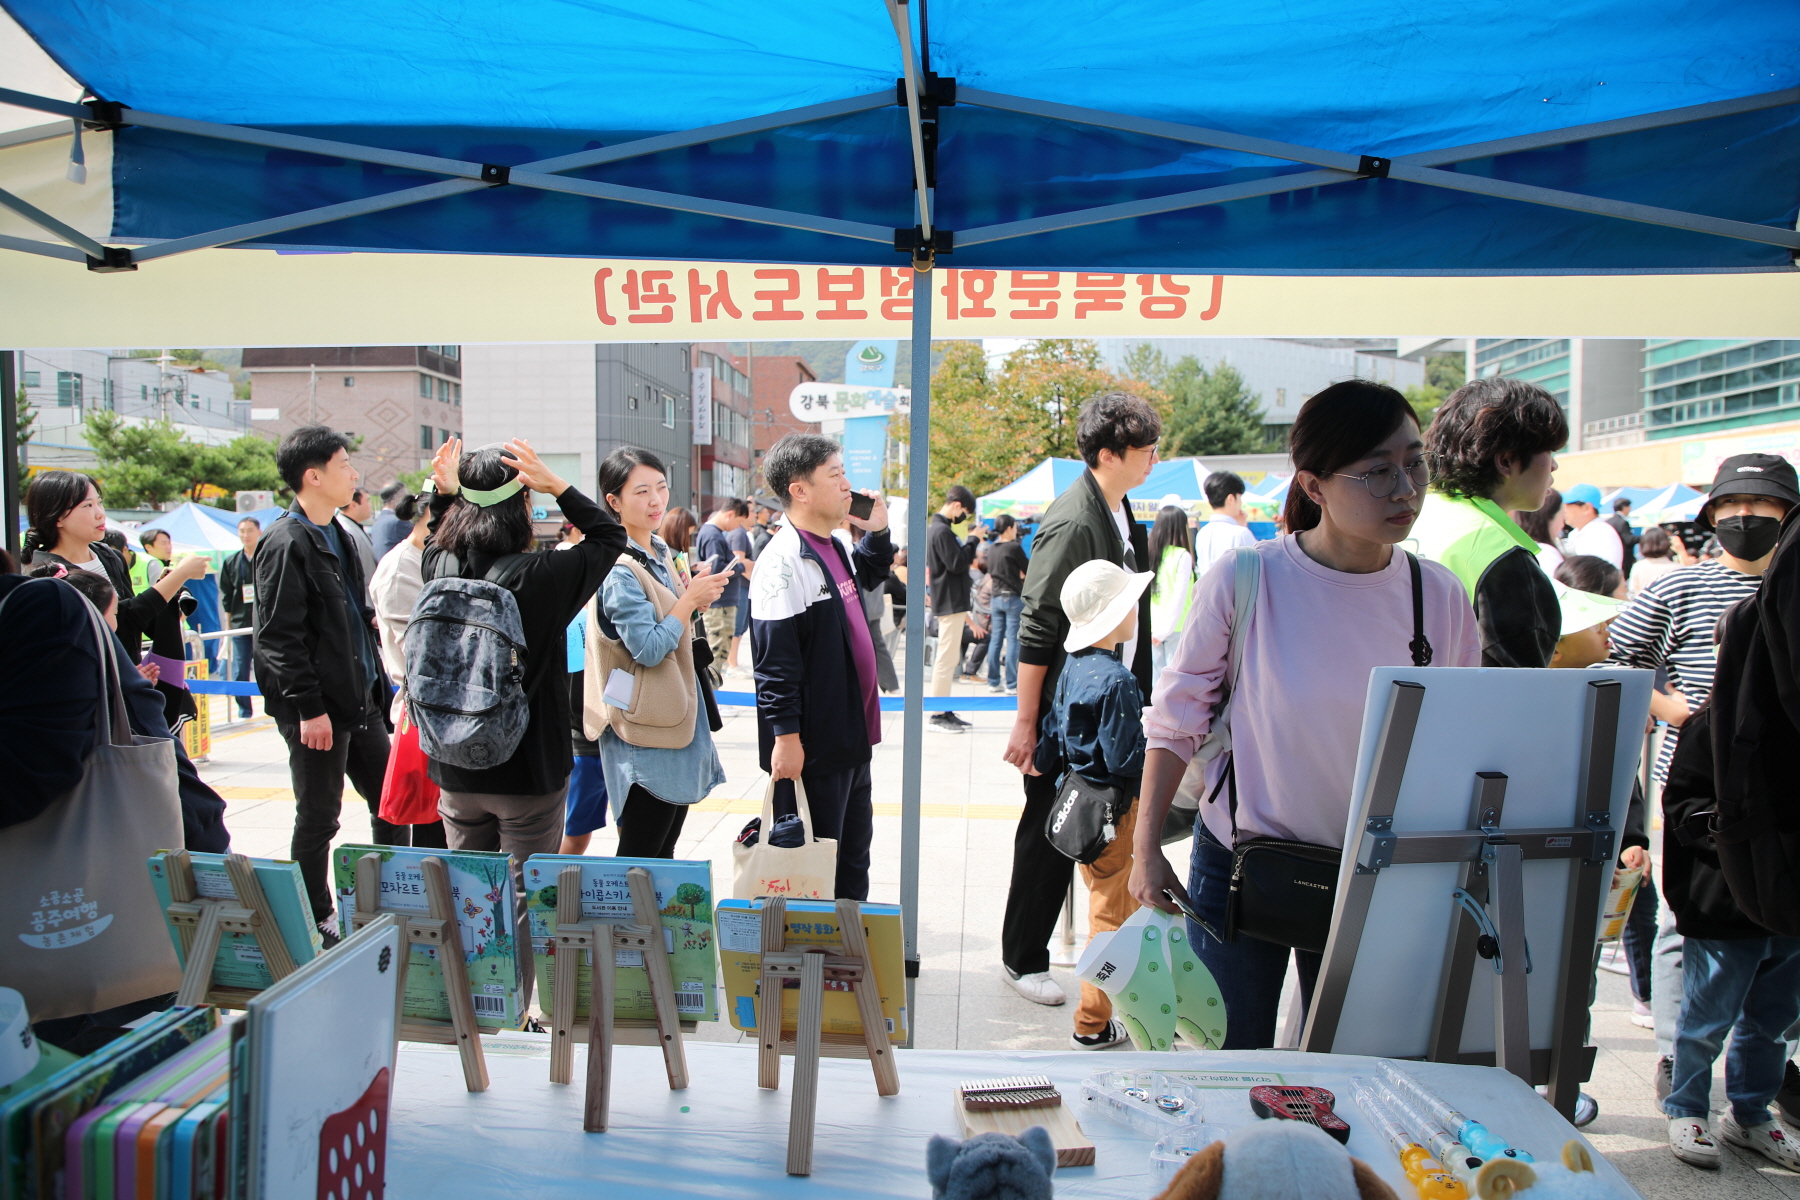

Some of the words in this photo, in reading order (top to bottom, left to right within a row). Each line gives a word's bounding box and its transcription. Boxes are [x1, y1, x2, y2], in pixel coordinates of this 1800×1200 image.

[800, 394, 830, 411] 강북
[833, 390, 910, 412] 문화예술회
[1052, 789, 1079, 833] adidas
[381, 881, 420, 894] 모차르트
[766, 879, 791, 893] Feel
[1293, 879, 1329, 890] LANCASTER
[40, 887, 85, 908] 소공소공
[30, 900, 98, 933] 공주여행
[790, 923, 812, 934] 명작
[814, 923, 835, 935] 동화
